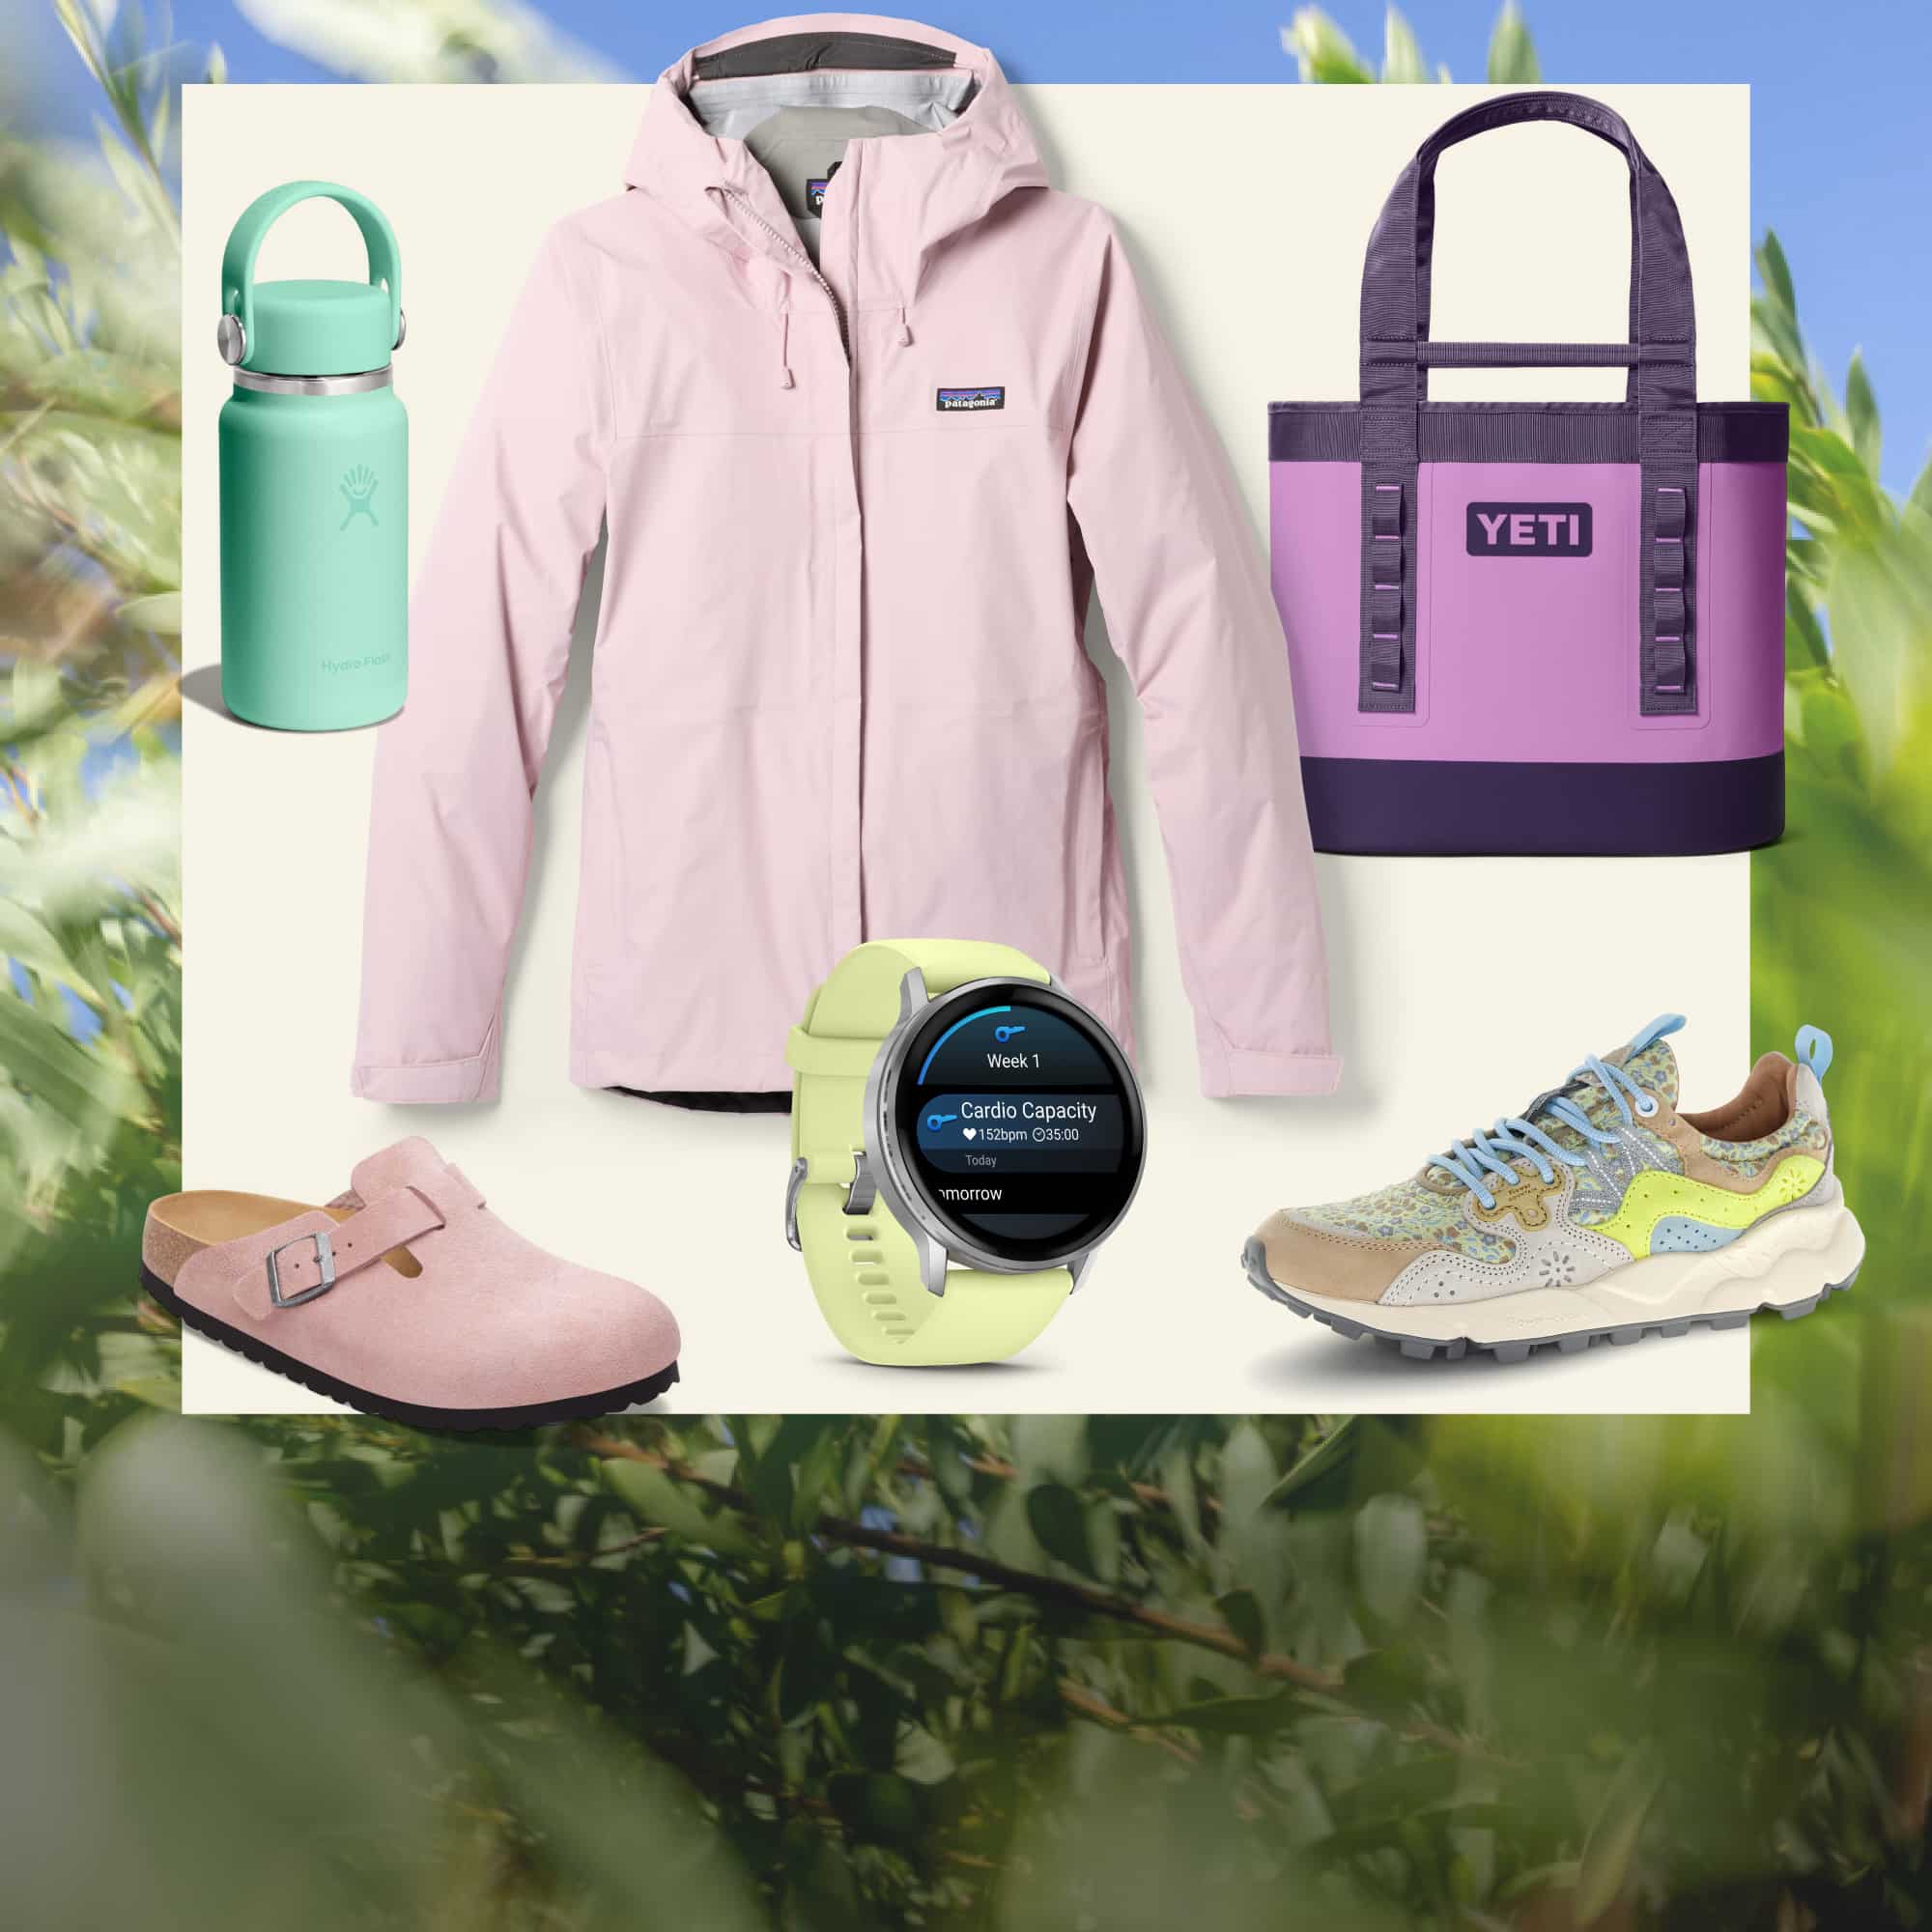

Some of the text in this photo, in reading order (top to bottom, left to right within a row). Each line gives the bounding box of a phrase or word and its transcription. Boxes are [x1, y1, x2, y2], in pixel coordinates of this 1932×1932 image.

[945, 398, 996, 409] patagonia
[1476, 513, 1579, 546] YETI
[321, 658, 361, 674] Hydro
[986, 1053, 1039, 1068] Week 1
[960, 1101, 1096, 1122] Cardio Capacity
[979, 1127, 1079, 1143] 152bpm 35:00
[966, 1154, 997, 1167] Today
[939, 1189, 1002, 1201] morrow
